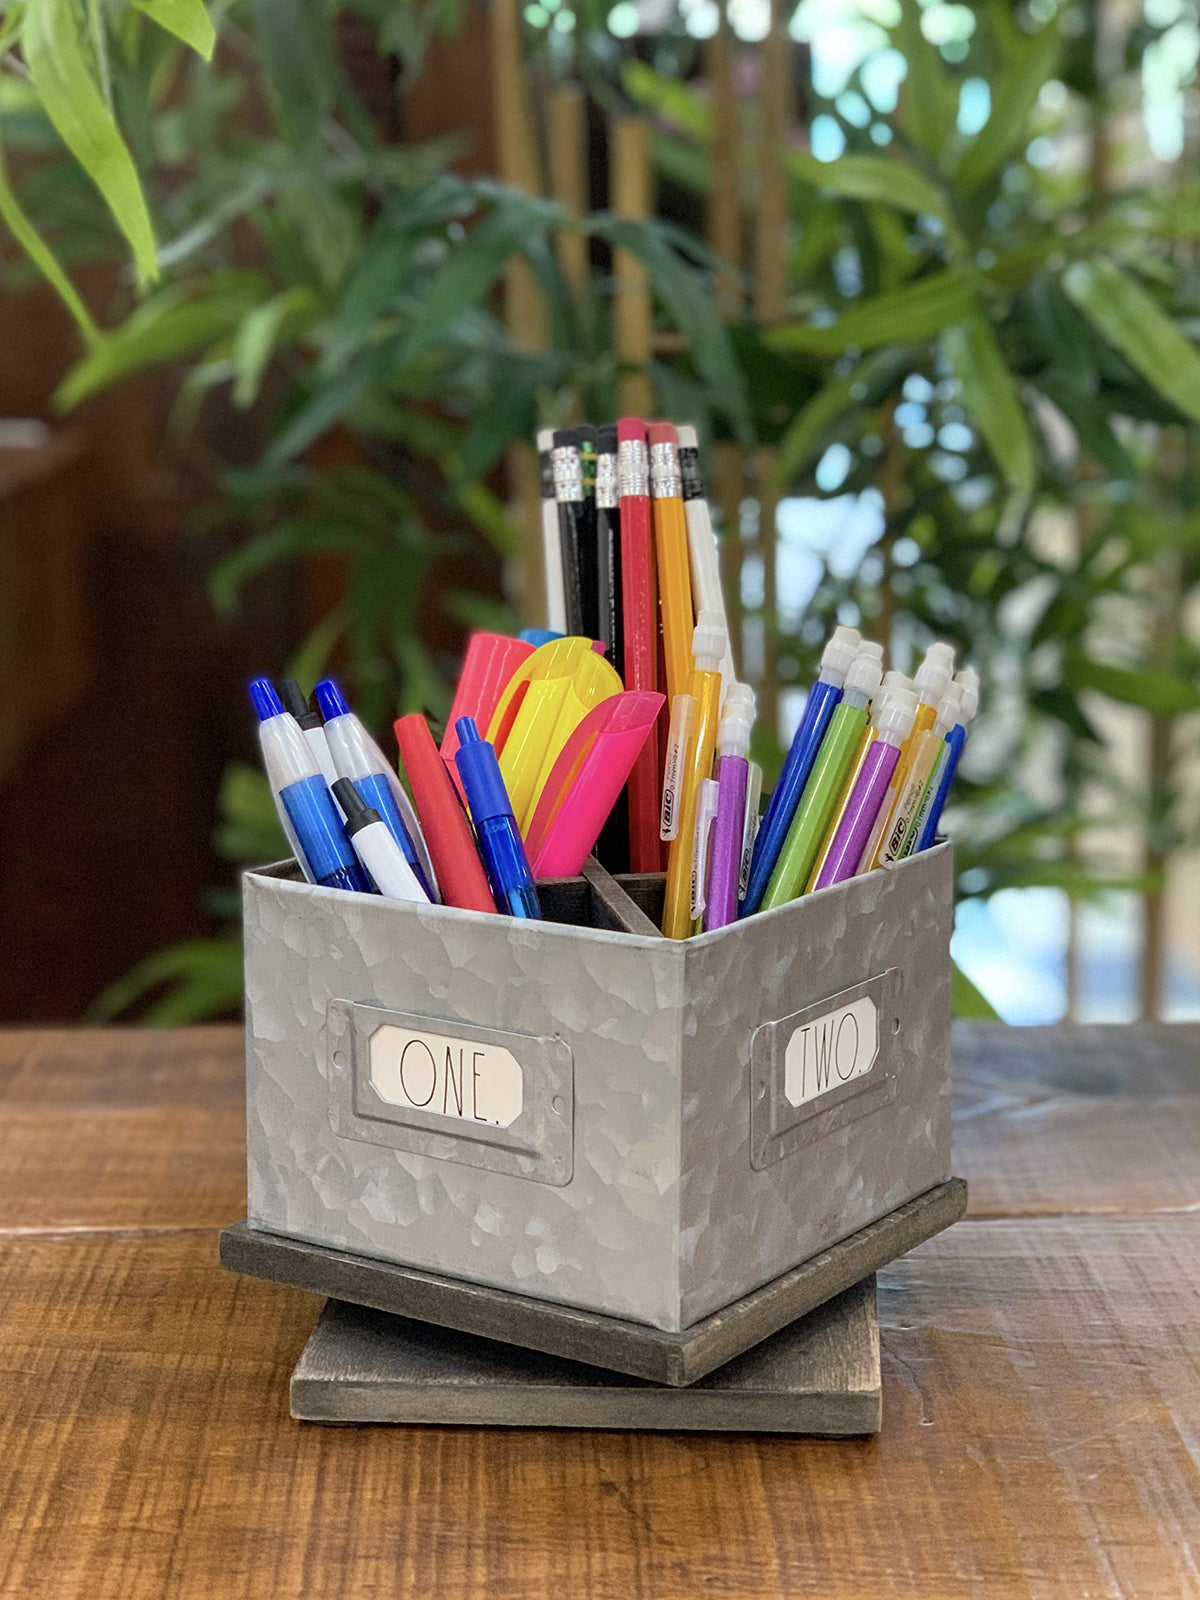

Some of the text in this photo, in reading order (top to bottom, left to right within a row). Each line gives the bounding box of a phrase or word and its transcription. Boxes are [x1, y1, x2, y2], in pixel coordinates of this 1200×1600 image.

[663, 791, 673, 824] BIC
[890, 818, 905, 853] BIC
[400, 1039, 499, 1125] ONE.
[801, 1012, 862, 1097] TWO.
